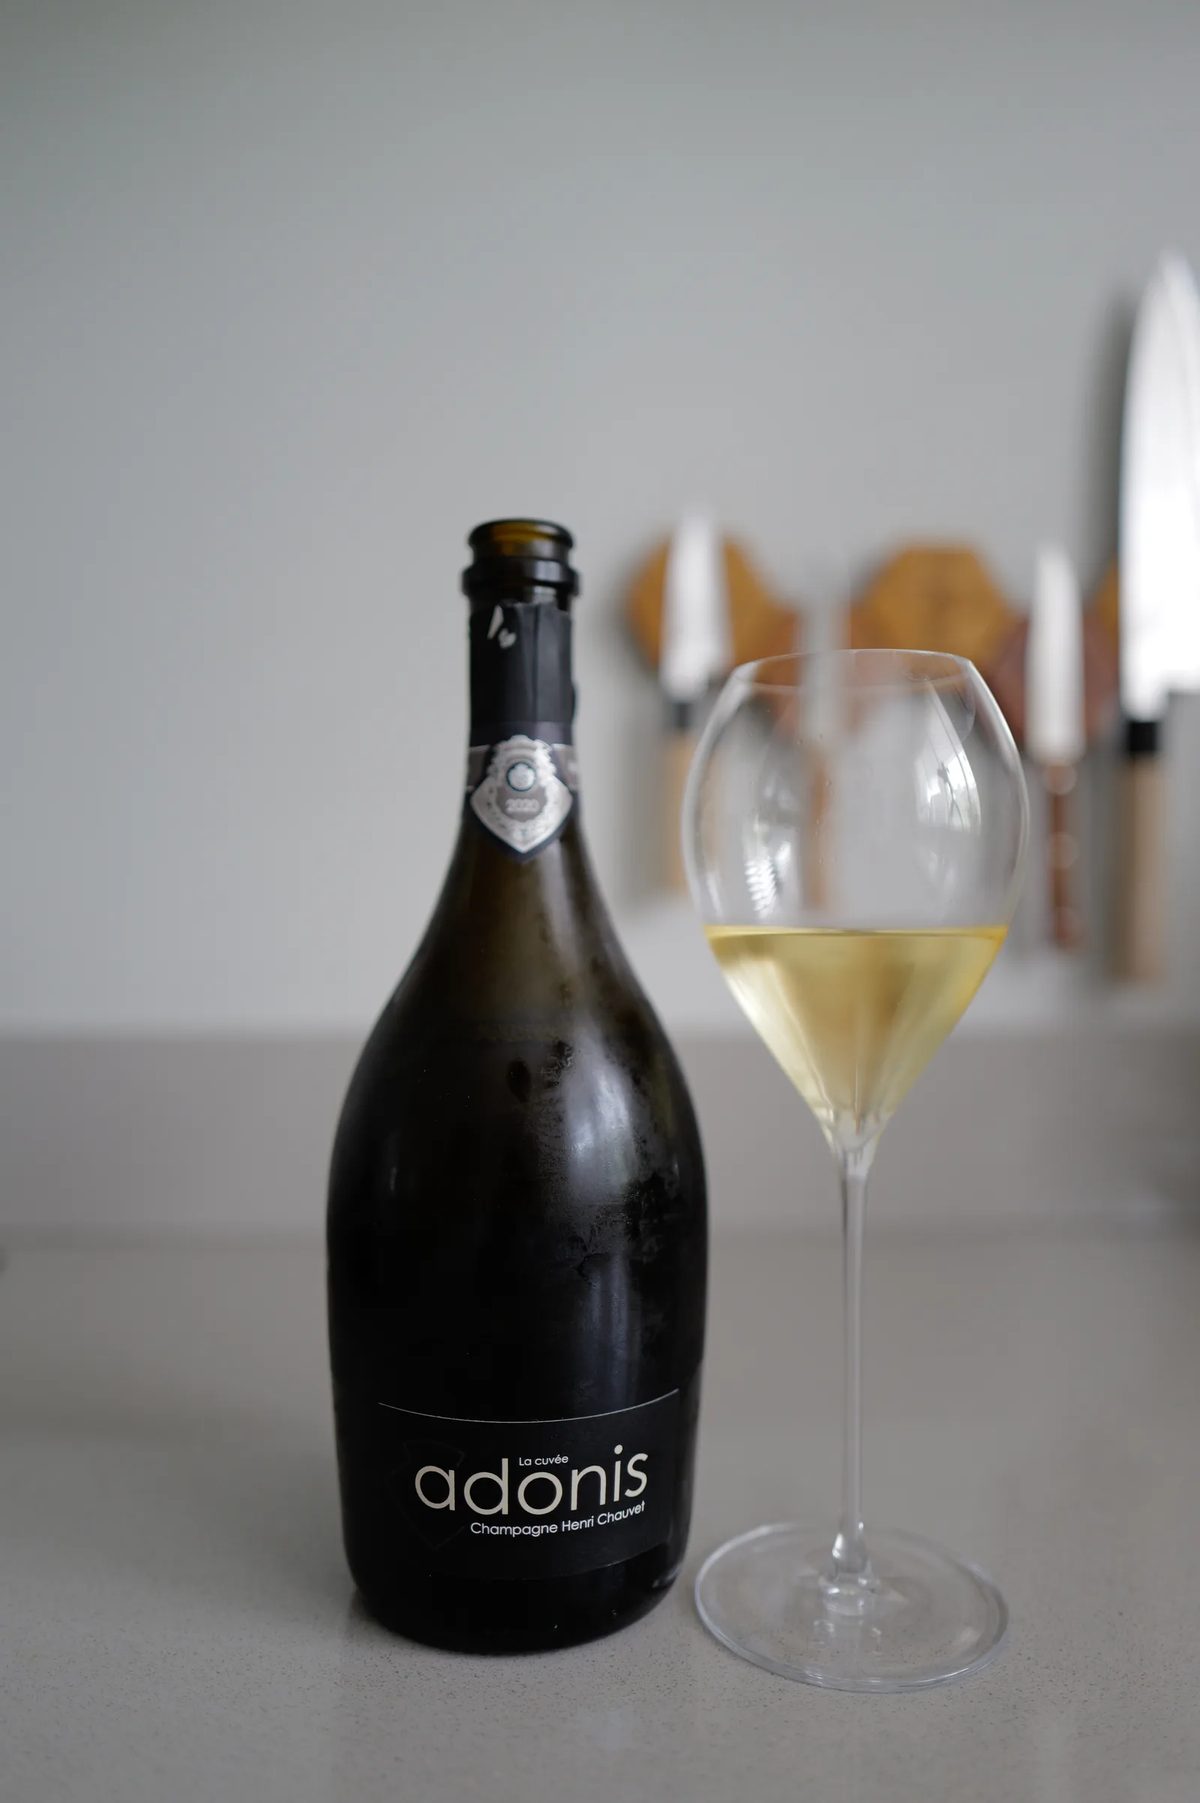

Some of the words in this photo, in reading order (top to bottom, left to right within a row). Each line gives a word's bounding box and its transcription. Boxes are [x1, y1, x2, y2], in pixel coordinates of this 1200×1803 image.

[518, 1457, 532, 1466] La
[535, 1454, 569, 1466] cuvée
[414, 1443, 649, 1516] adonis
[470, 1522, 558, 1538] Champagne
[561, 1515, 594, 1532] Henri
[597, 1500, 646, 1526] Chauvet
